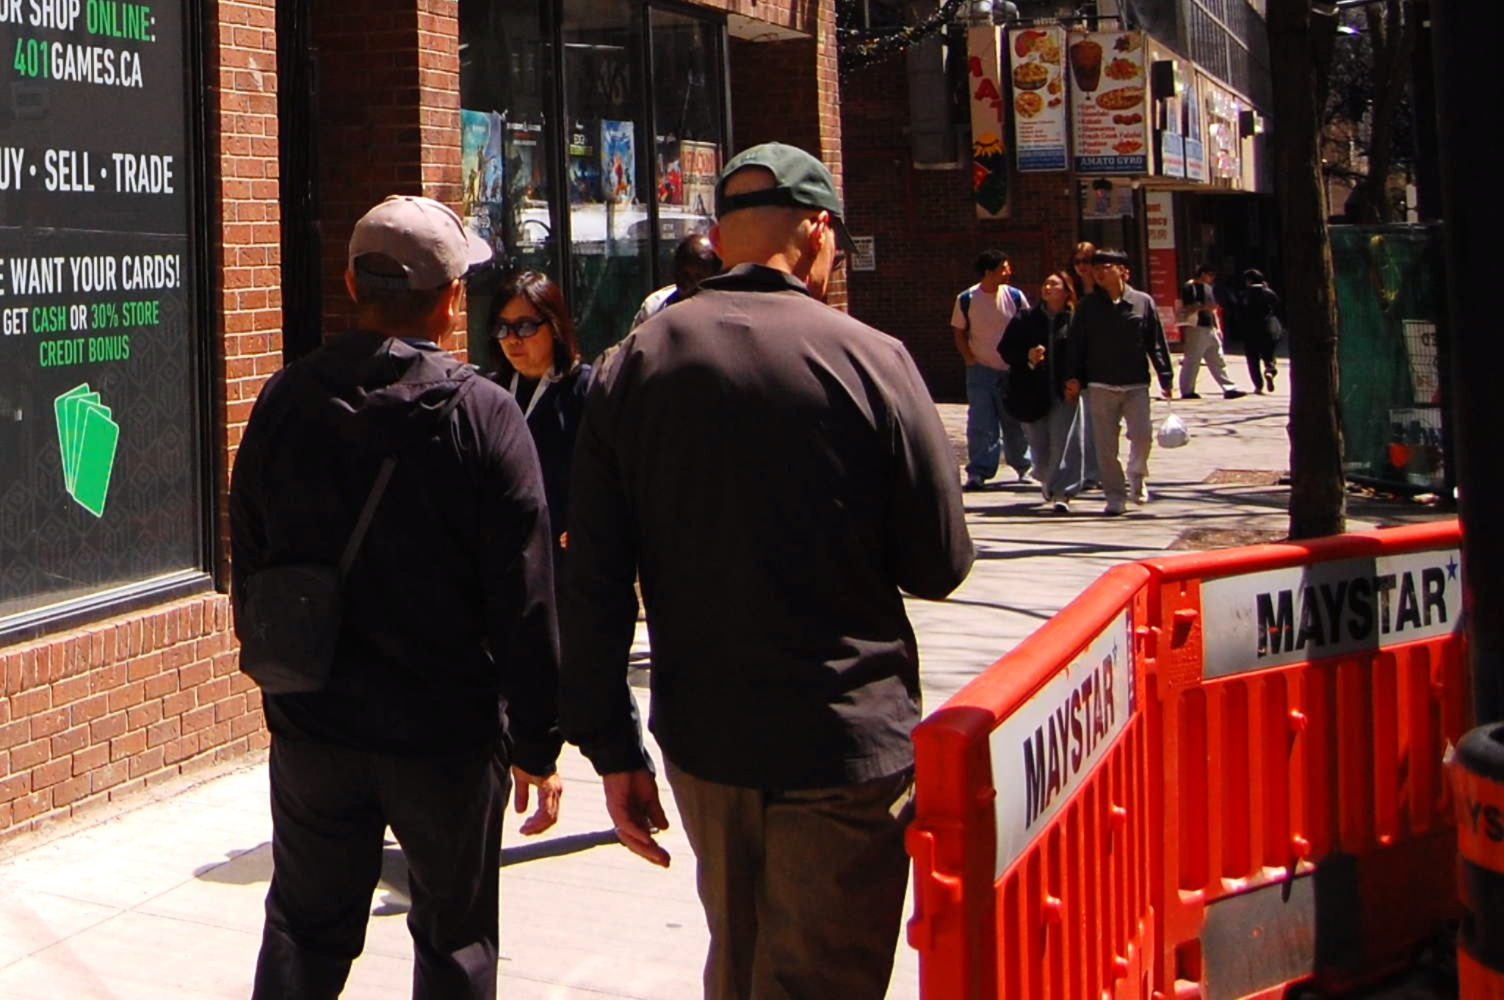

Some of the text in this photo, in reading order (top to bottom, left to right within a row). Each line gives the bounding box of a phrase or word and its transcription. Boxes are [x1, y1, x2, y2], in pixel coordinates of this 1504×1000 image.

[14, 38, 144, 89] 401GAMES.CA
[44, 148, 95, 192] SELL
[112, 152, 174, 195] TRADE
[1080, 157, 1115, 166] AMATO
[10, 257, 65, 295] WANT
[70, 256, 117, 292] YOUR
[121, 254, 181, 290] CARDS!
[3, 300, 160, 336] GET CASH OR 30% STORE
[39, 335, 130, 368] CREDIT BONUS
[1256, 566, 1448, 659] MAYSTAR
[1022, 658, 1115, 828] MAYSTAR
